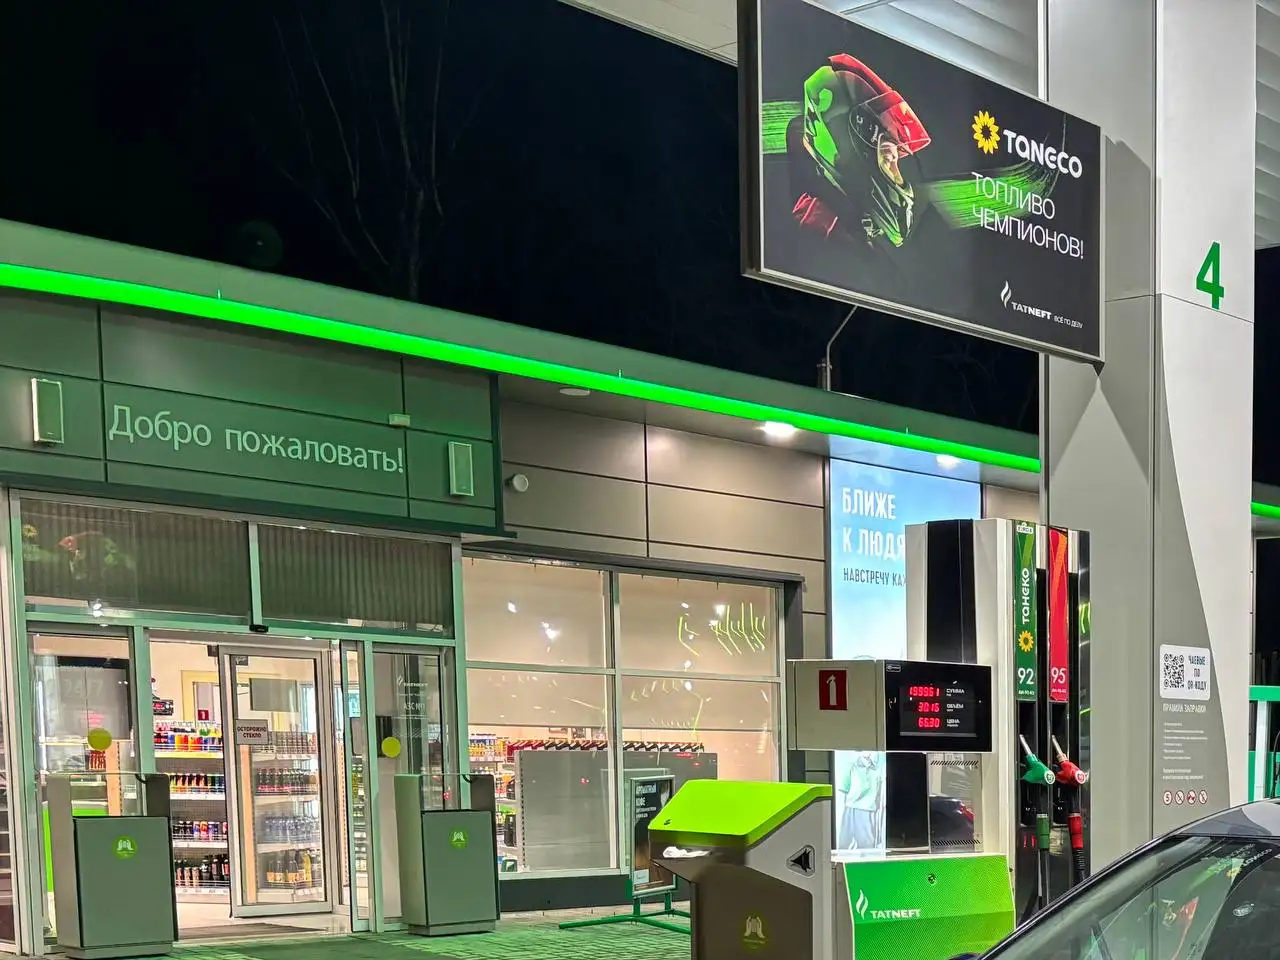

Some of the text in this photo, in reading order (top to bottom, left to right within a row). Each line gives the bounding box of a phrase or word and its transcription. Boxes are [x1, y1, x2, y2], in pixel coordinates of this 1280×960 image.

[971, 171, 1056, 220] ТОПЛИВО
[972, 203, 1084, 260] ЧЕМПИОНОВ!
[1196, 241, 1225, 310] 4
[1011, 301, 1052, 320] TATNEFT
[109, 404, 404, 473] Добро пожаловать!
[842, 487, 897, 520] БЛИЖЕ
[842, 526, 905, 561] К ЛЮДЯ
[843, 567, 906, 587] НАВСТРЕЧУ КА
[1022, 567, 1030, 625] ТАНЕКО
[1017, 667, 1035, 685] 92
[1051, 667, 1068, 684] 95
[870, 908, 921, 919] TATNEFT
